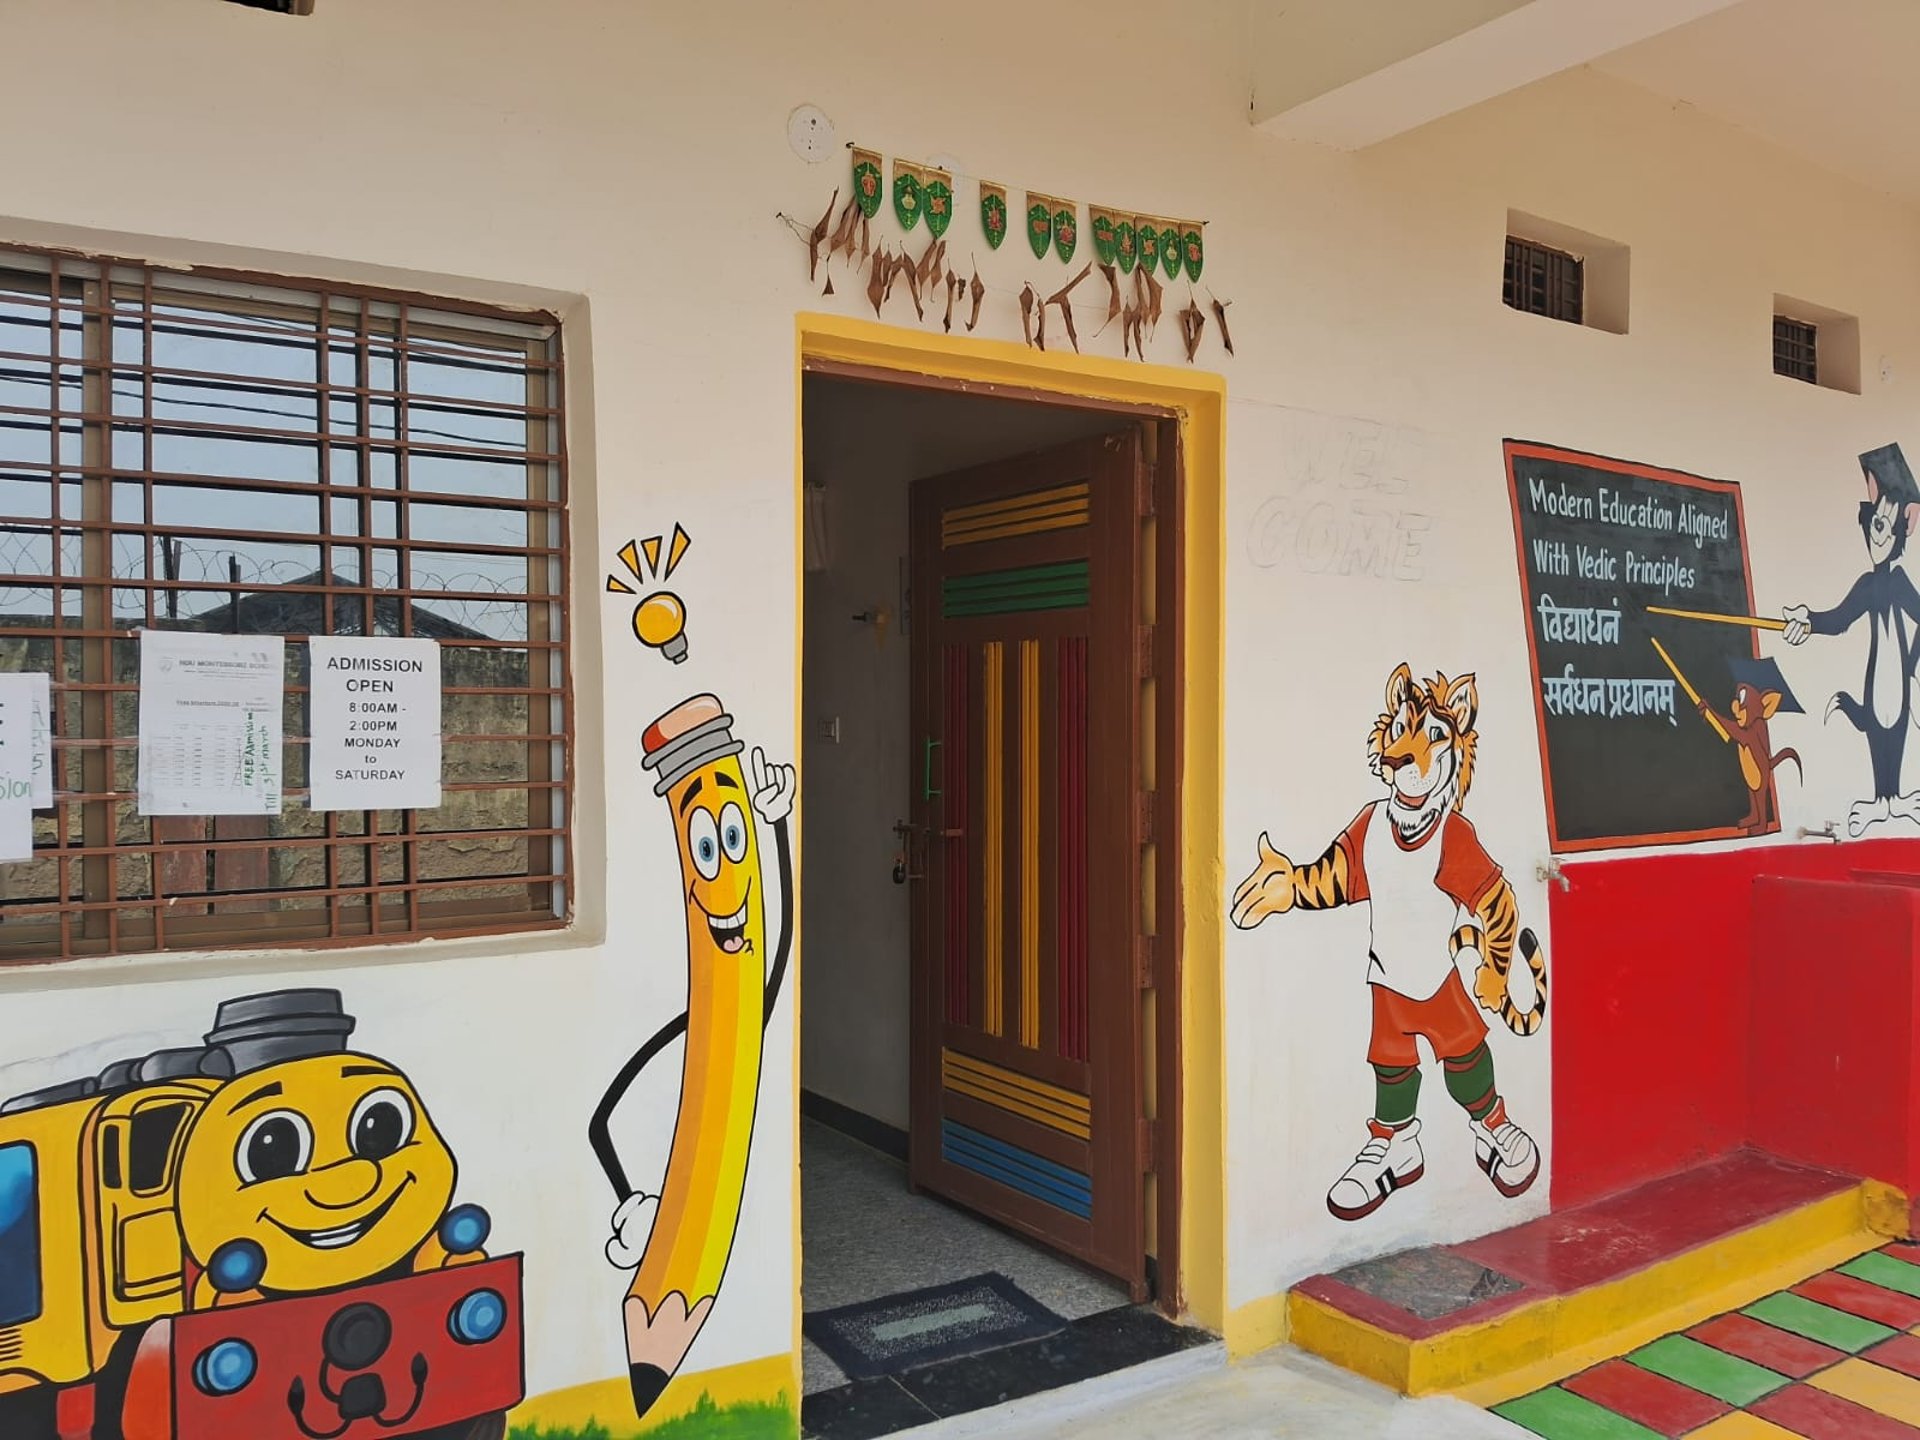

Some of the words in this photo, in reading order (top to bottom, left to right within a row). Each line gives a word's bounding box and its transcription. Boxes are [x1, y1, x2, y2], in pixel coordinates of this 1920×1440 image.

[1528, 477, 1593, 520] Modern
[1598, 487, 1673, 531] Education
[1677, 503, 1728, 550] Aligned
[1532, 538, 1570, 576] With
[1575, 544, 1617, 582] Vedic
[1625, 550, 1696, 597] Principles
[1536, 592, 1622, 646] विद्याधनं
[327, 656, 423, 673] ADMISSION
[346, 678, 394, 693] OPEN
[1542, 662, 1606, 717] सर्वधन
[1606, 678, 1678, 727] प्रधानम्
[348, 702, 398, 714] 8:00AM
[349, 720, 398, 732] 2:00PM
[344, 737, 401, 749] MONDAY
[365, 753, 378, 765] to
[335, 769, 406, 781] SATURDAY
